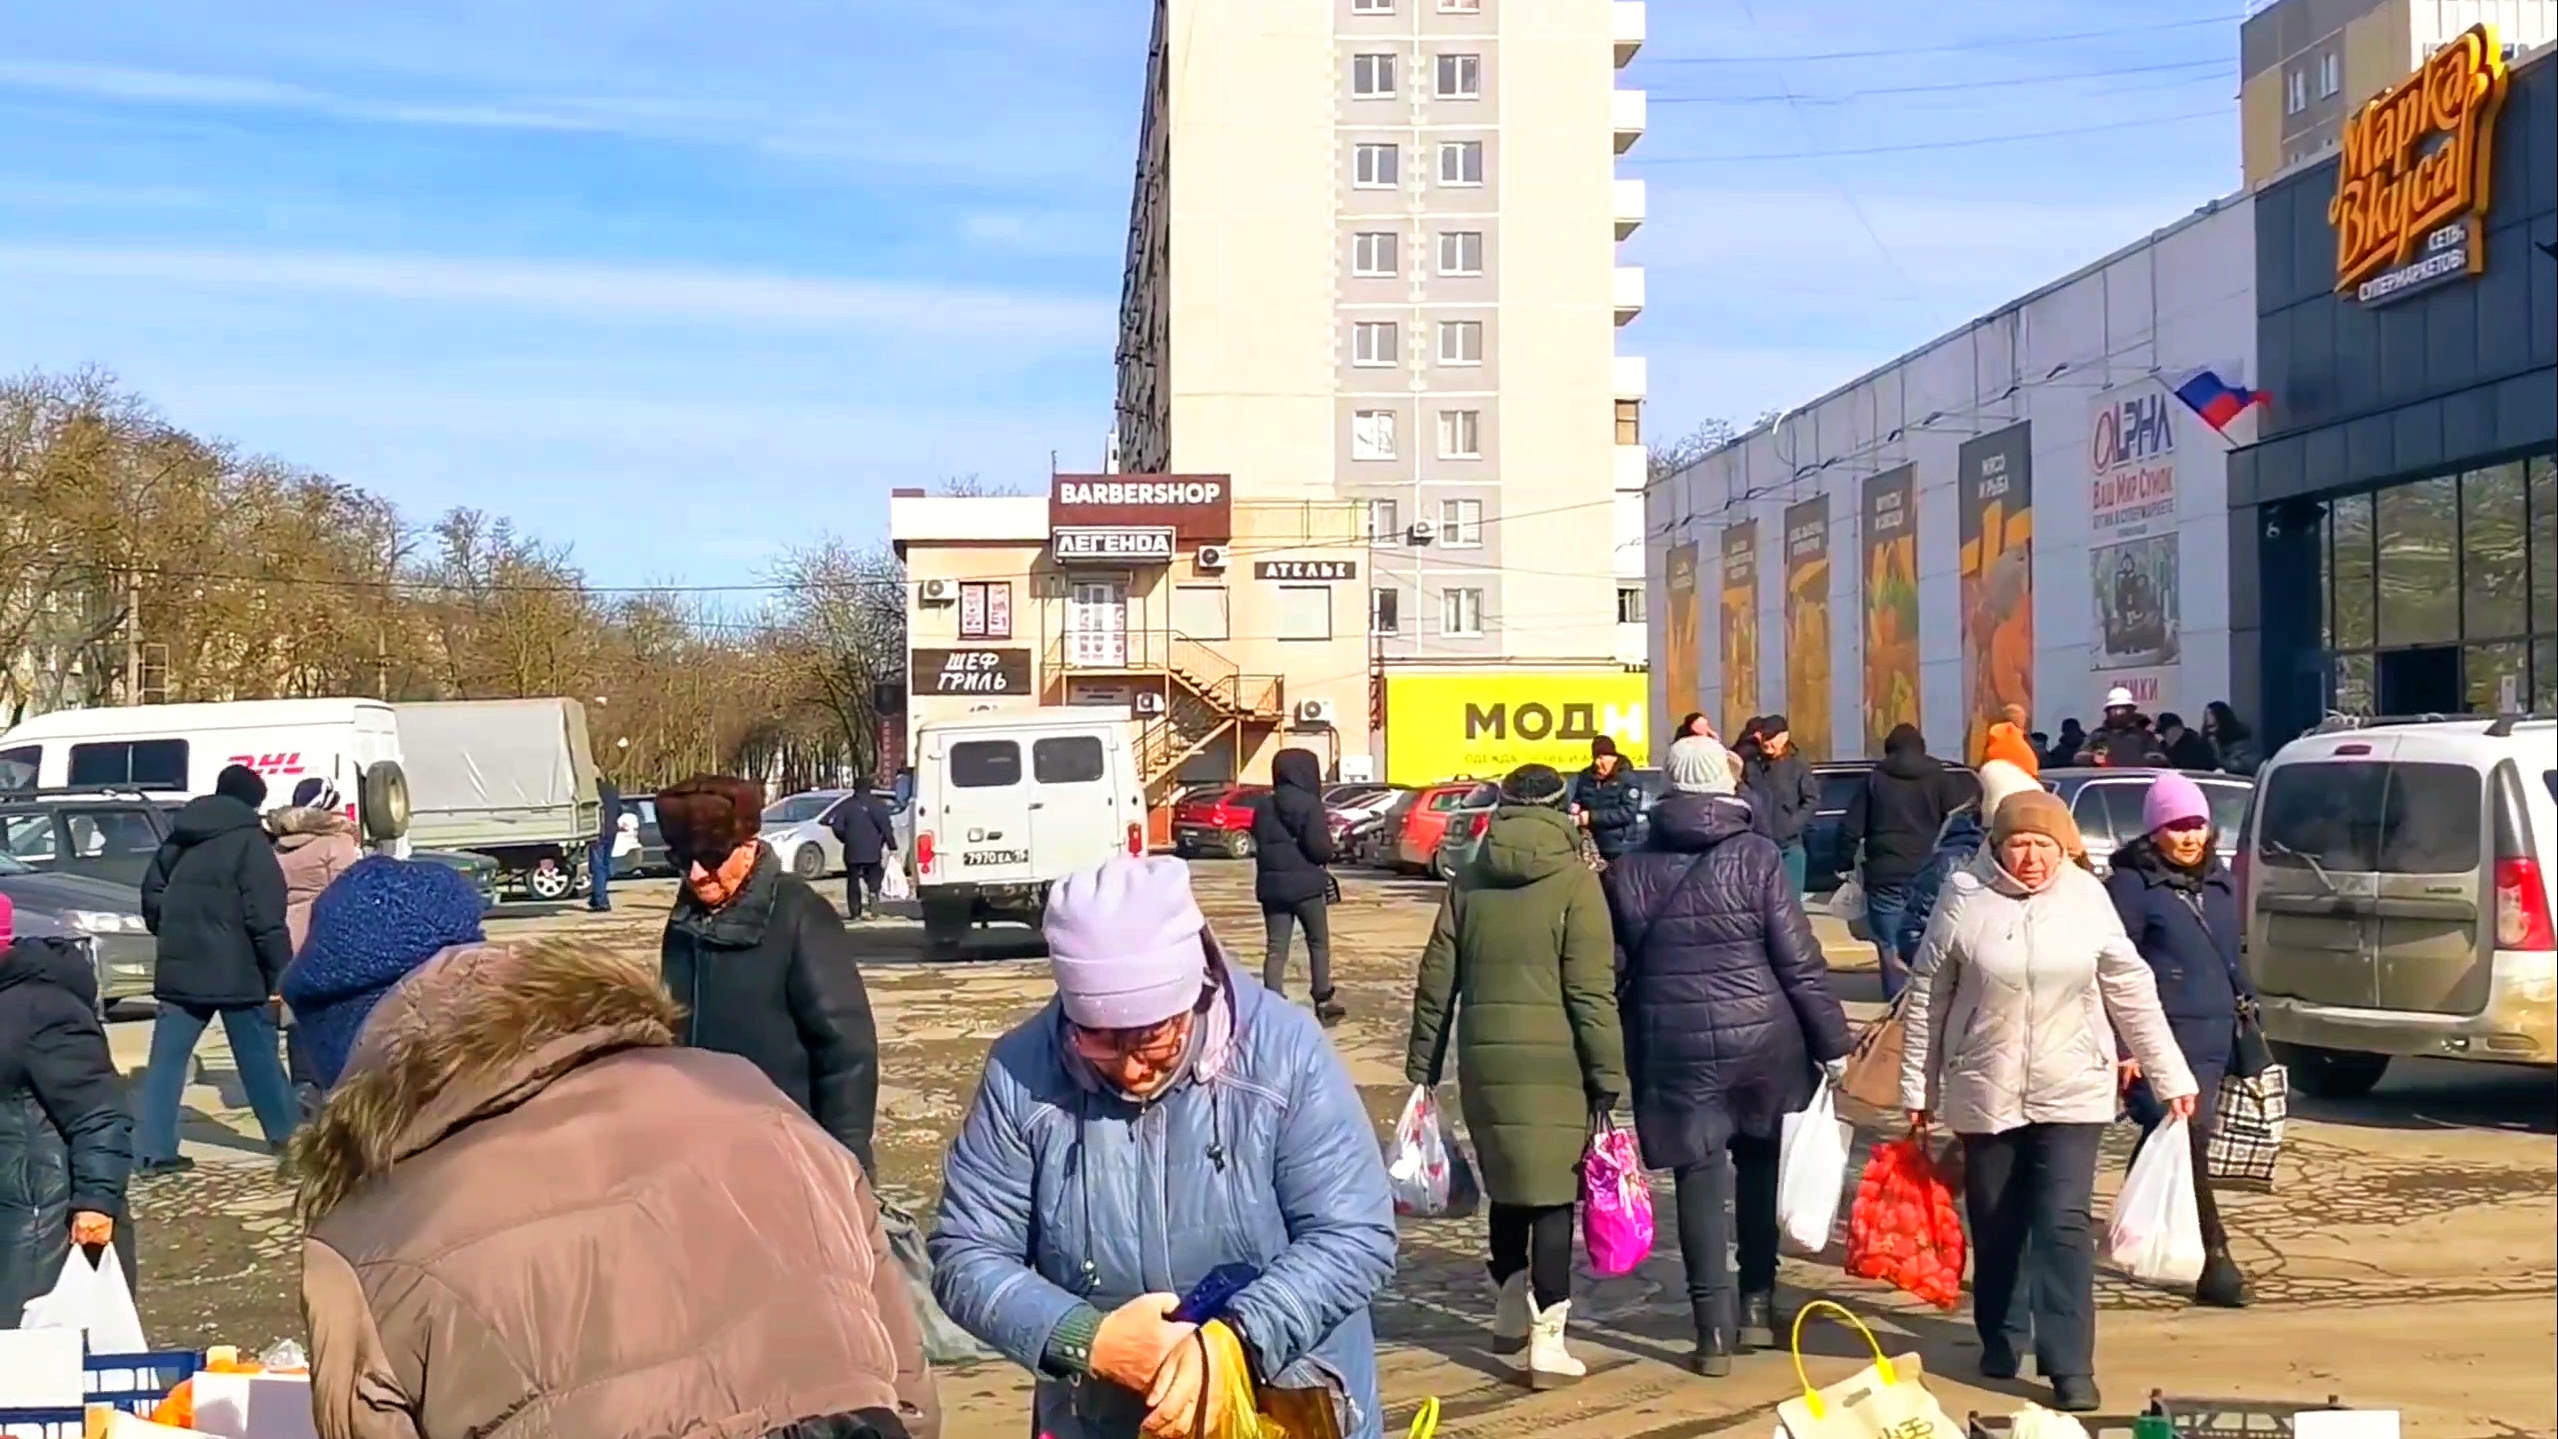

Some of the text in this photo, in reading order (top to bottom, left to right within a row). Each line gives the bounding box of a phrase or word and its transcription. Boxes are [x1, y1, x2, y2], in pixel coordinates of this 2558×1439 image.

[2329, 50, 2468, 222] Марка
[2337, 137, 2457, 271] Вкуса
[2428, 223, 2466, 251] СЕТЬ
[2359, 248, 2466, 301] СУПЕРМАРКЕТОВ
[2095, 394, 2173, 469] ALPHA
[1060, 483, 1221, 504] BARBERSHOP
[1265, 562, 1346, 578] АТЕЛЬЕ
[944, 652, 999, 671] ШЕФ
[937, 672, 1008, 691] ГРИЛЬ
